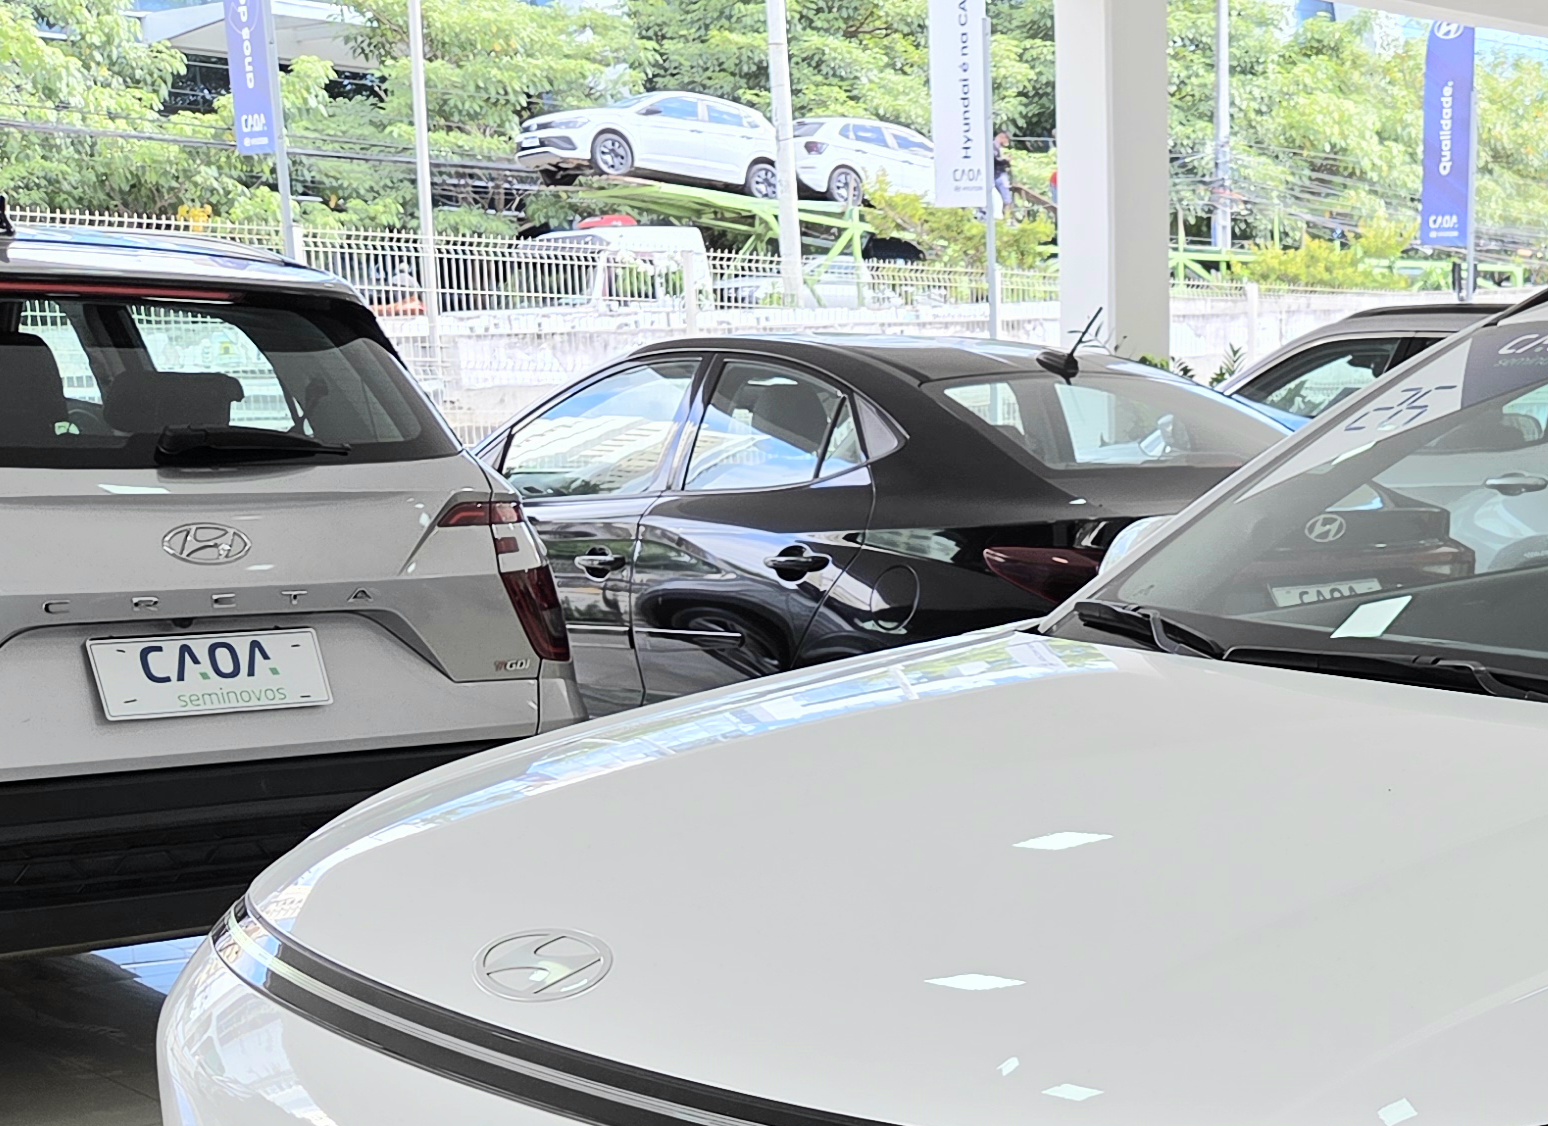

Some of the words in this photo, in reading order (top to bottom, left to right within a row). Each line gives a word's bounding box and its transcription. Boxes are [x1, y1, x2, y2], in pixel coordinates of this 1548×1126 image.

[960, 32, 969, 56] na
[241, 27, 255, 89] anos
[241, 113, 268, 133] CAOA
[958, 78, 973, 160] Hyundai
[952, 168, 982, 182] CAOA
[1428, 215, 1459, 229] CAOA
[42, 587, 374, 614] CRETA
[1298, 585, 1359, 604] CAOA
[139, 639, 281, 684] CAOA
[177, 685, 287, 708] seminovos
